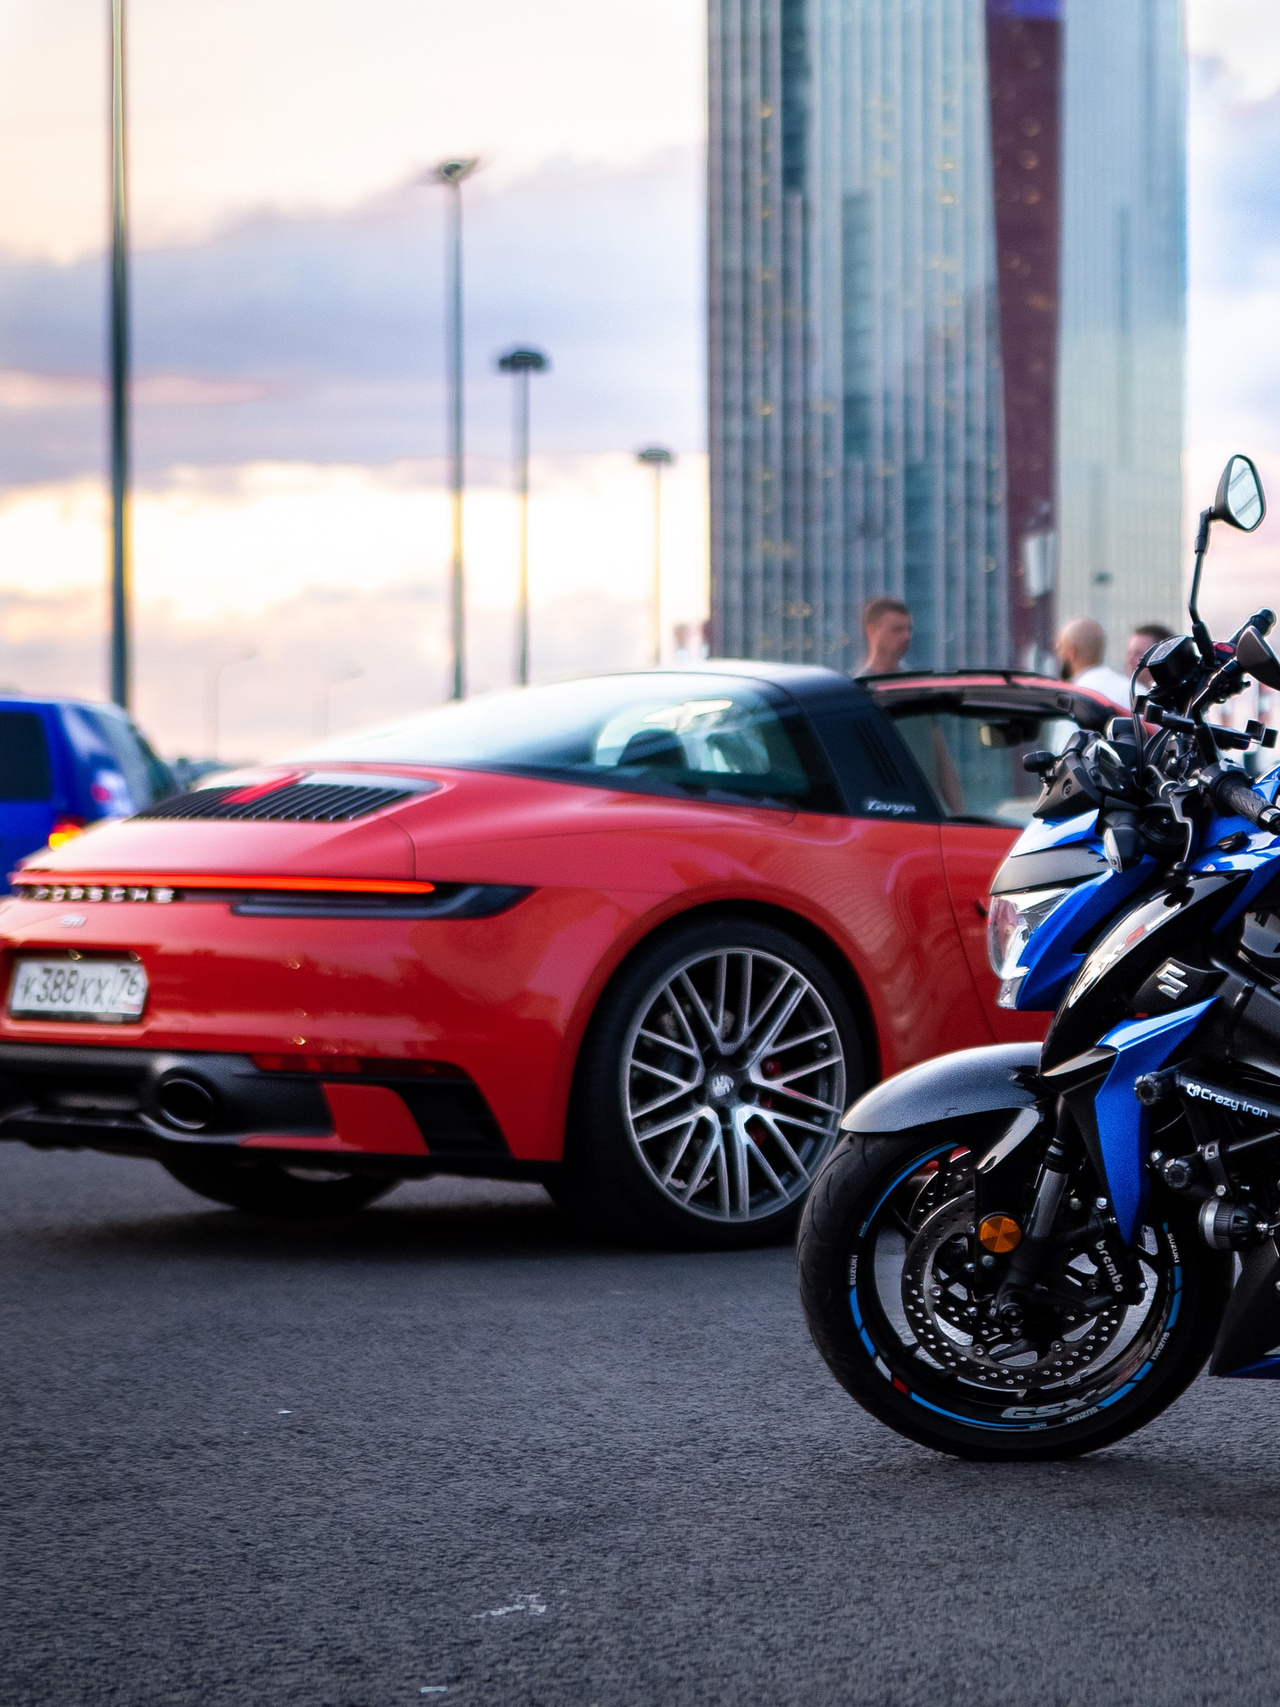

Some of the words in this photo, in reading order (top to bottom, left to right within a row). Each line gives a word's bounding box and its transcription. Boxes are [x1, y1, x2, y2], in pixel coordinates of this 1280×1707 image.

[866, 799, 917, 815] Targa
[1200, 1088, 1240, 1111] Crazy
[1241, 1101, 1269, 1119] Iron
[1166, 1232, 1180, 1263] SUZUKI
[849, 1254, 859, 1286] SUZUKI
[1095, 1239, 1124, 1293] brembo
[1150, 1331, 1170, 1361] SUZUKI
[1066, 1406, 1099, 1424] SUZUKI
